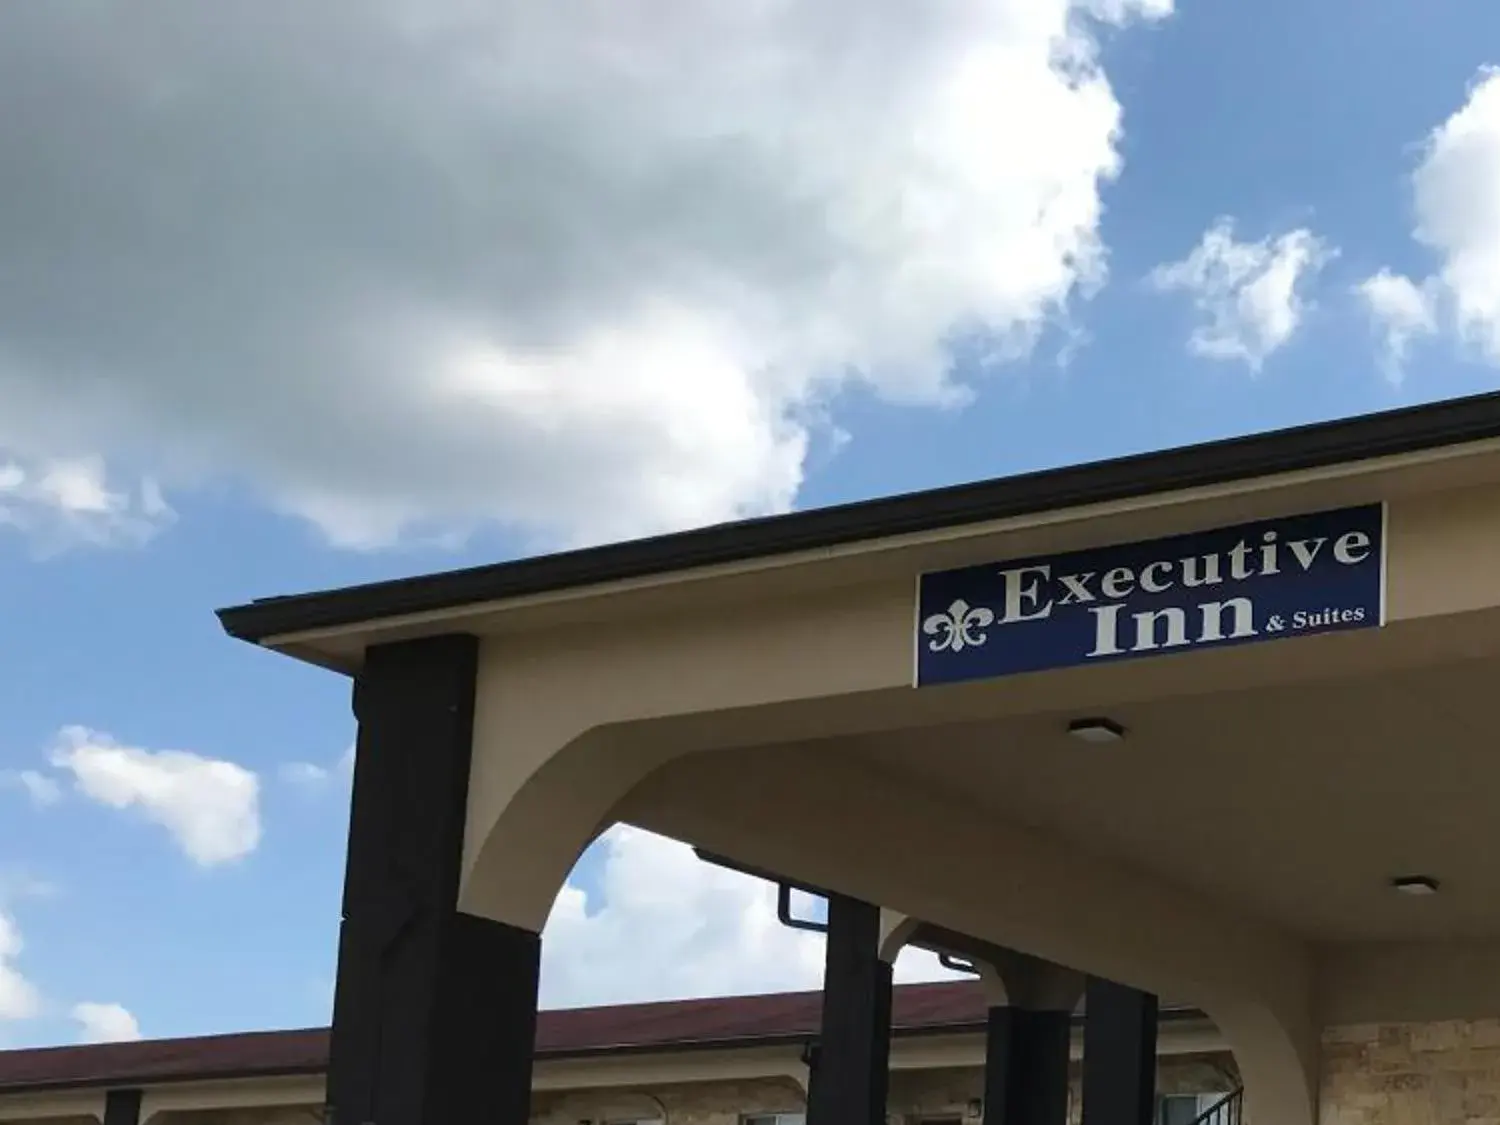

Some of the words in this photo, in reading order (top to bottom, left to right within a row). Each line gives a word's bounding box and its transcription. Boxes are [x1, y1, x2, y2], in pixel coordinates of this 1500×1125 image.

[998, 529, 1371, 624] Executive
[1086, 596, 1258, 657] Inn
[1265, 620, 1286, 632] &
[1292, 607, 1365, 629] Suites
